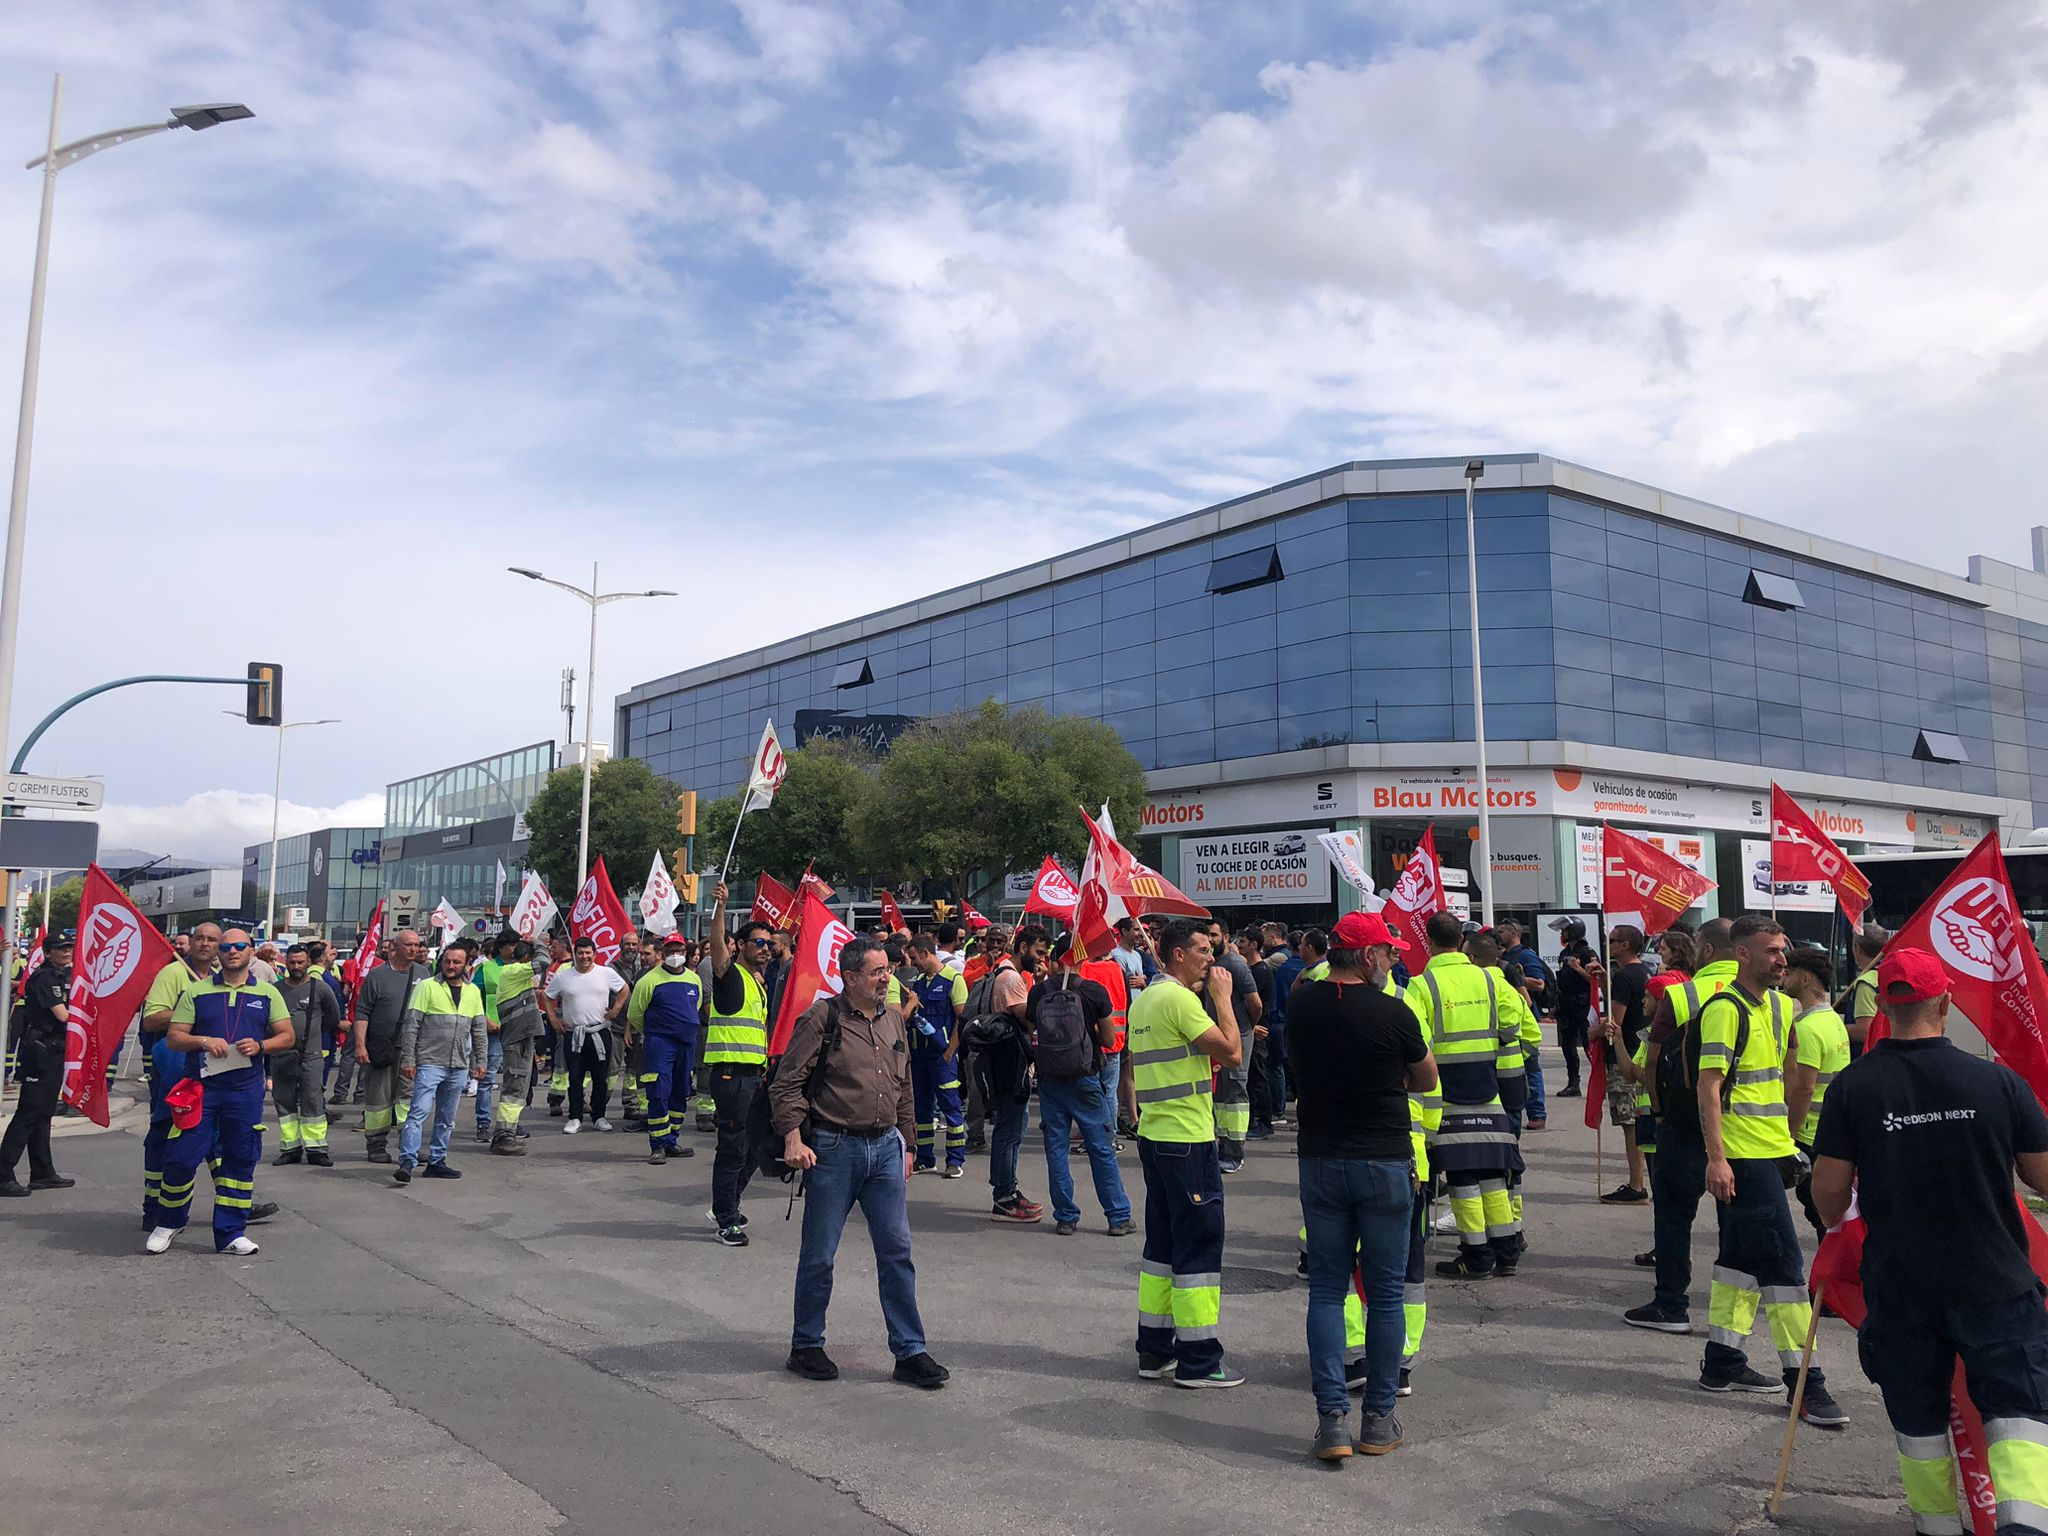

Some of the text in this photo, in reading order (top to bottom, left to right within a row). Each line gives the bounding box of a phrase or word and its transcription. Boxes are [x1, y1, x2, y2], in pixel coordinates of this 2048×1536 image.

[8, 782, 90, 797] C/ GREMI FUSTERS
[1373, 787, 1432, 808] Blau
[1592, 781, 1678, 801] Vehículos de ocasión
[1139, 803, 1204, 826] Motors
[1313, 803, 1338, 811] SEAT
[1593, 800, 1648, 814] garantizados
[1657, 808, 1671, 817] Grupo
[1671, 811, 1696, 819] Volkswagen
[1813, 809, 1864, 834] Motors
[1927, 819, 1942, 834] Das
[1195, 841, 1270, 858] VEN A ELEGIR
[1497, 851, 1542, 865] busques.
[1196, 854, 1307, 874] TU COCHE DE OCASIÓN
[1196, 873, 1308, 892] AL MEJOR PRECIO
[584, 905, 621, 966] FICA
